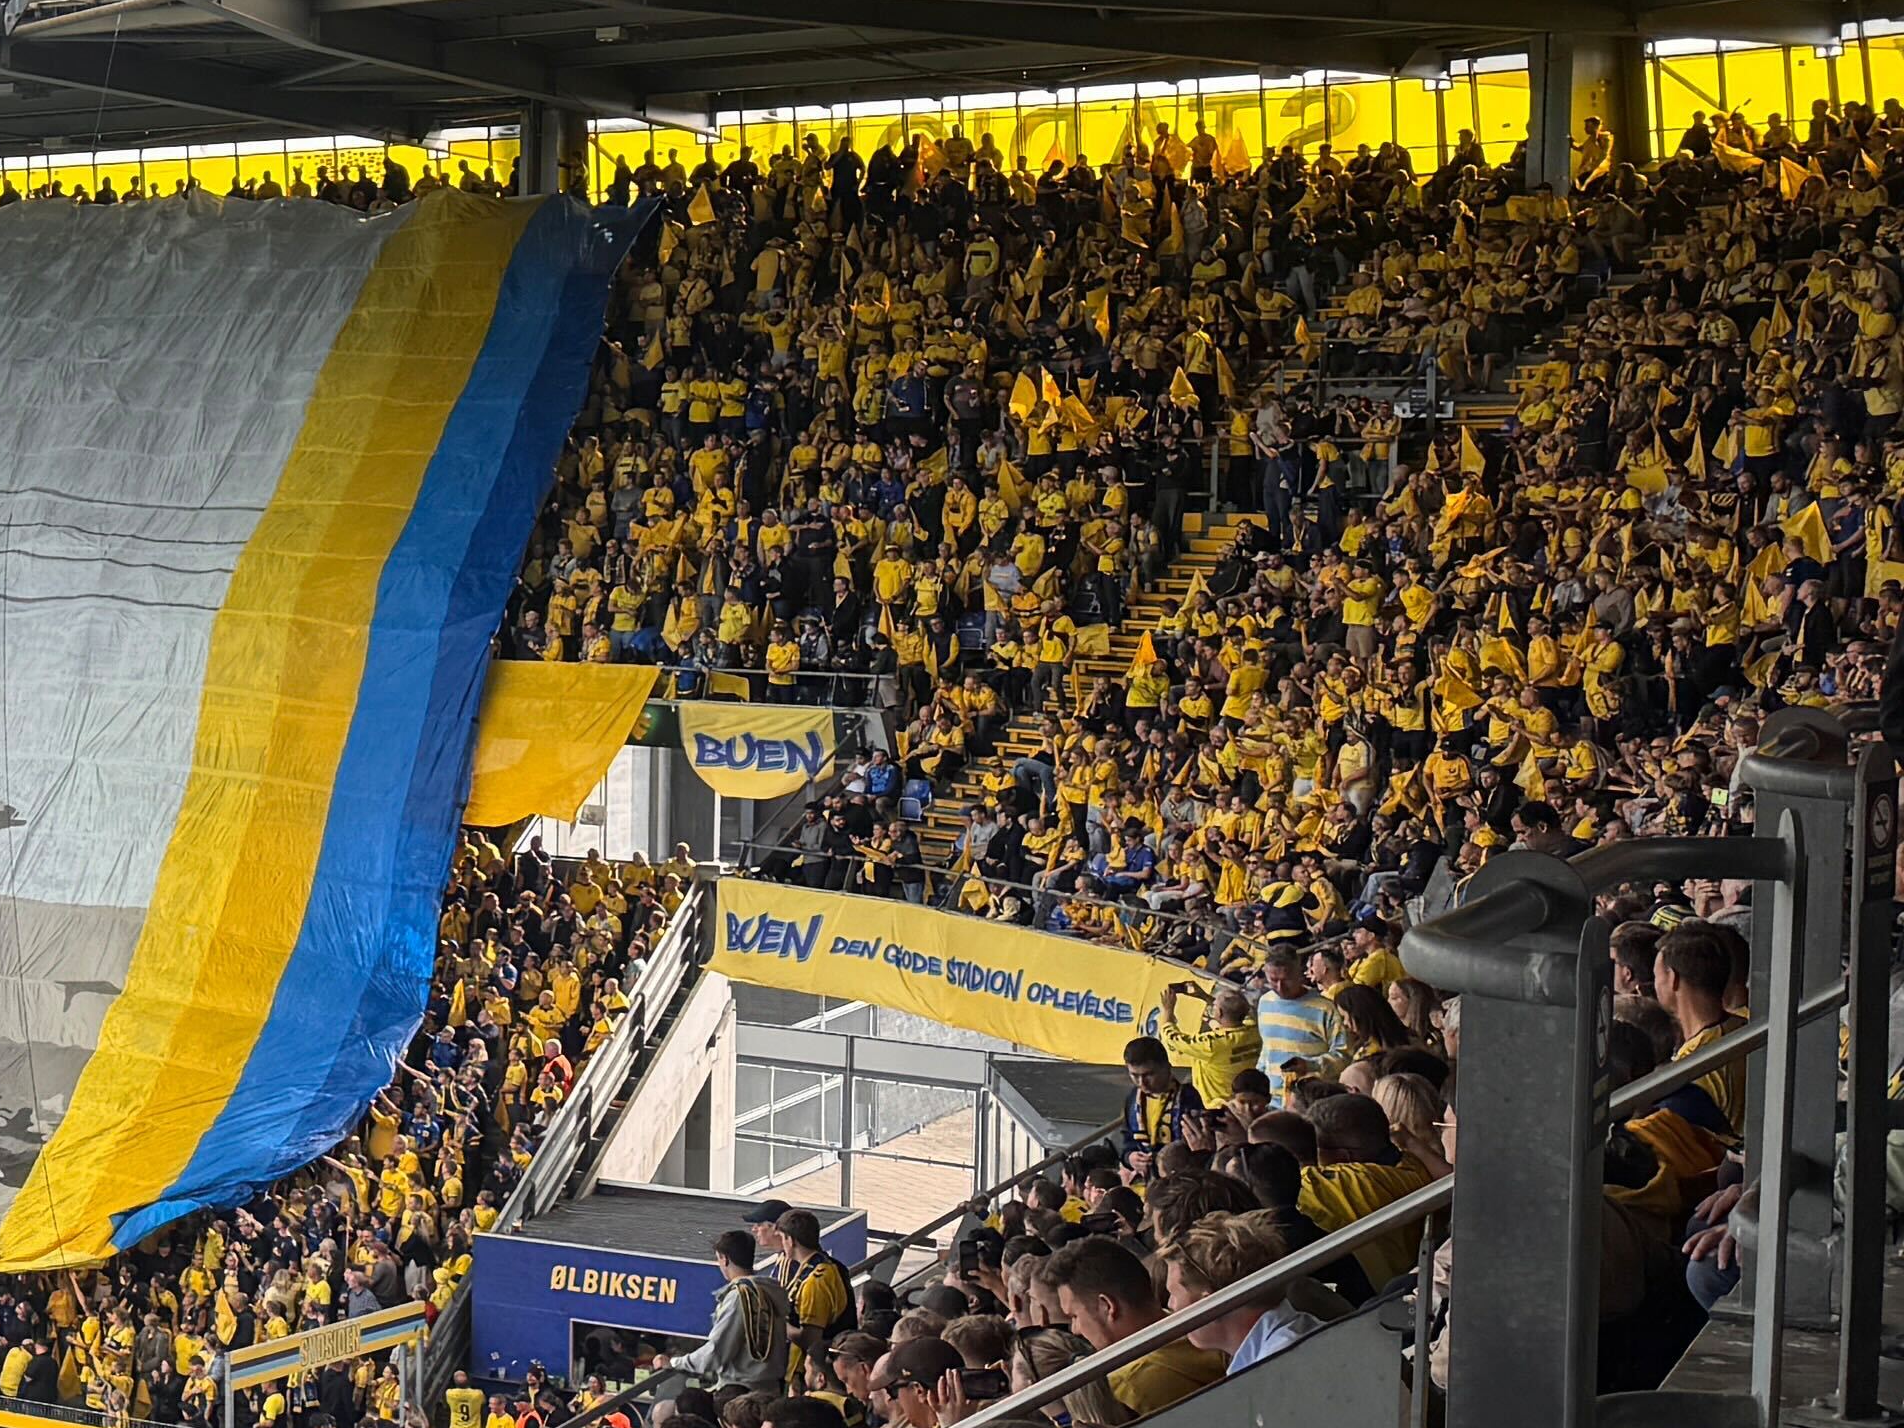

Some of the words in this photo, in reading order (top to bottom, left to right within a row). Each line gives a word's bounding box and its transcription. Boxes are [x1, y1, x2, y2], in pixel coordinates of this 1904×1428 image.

[694, 728, 826, 774] BUEN
[726, 912, 824, 963] BUEN
[830, 936, 883, 959] DEN
[883, 943, 943, 977] GODE
[946, 956, 1025, 1001] STADION
[1026, 982, 1134, 1024] OPLEVELSE
[550, 1263, 677, 1305] ØLBIKSEN
[298, 1322, 362, 1370] SYDSIDEN
[458, 1404, 471, 1422] 9
